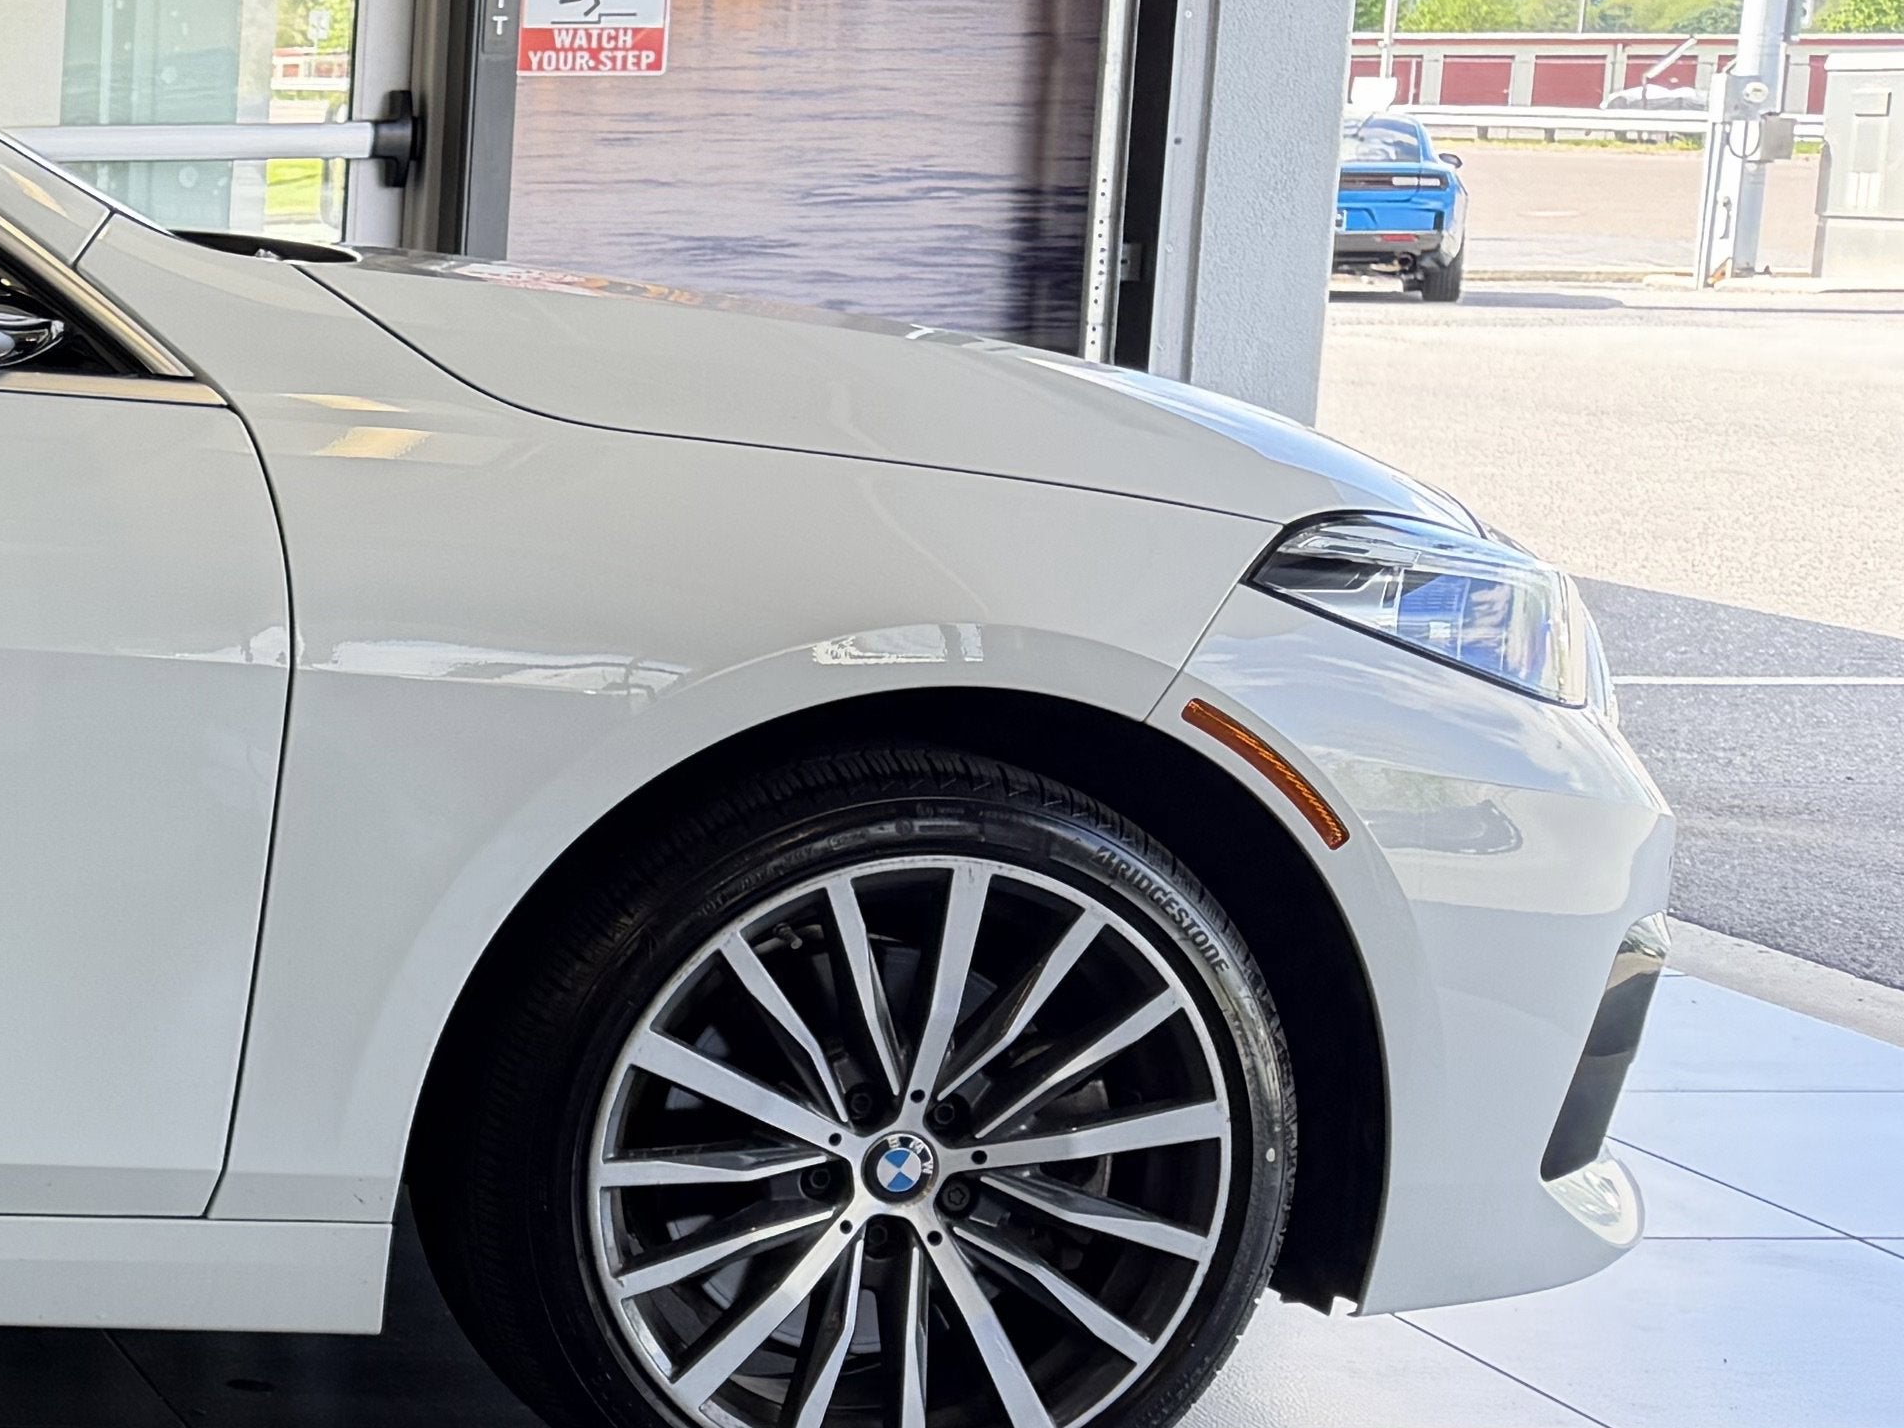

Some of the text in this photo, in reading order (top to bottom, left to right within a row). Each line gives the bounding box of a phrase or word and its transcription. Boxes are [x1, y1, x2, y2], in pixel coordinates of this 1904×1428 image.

[553, 28, 633, 49] WATCH
[528, 50, 656, 71] YOUR STEP
[1092, 845, 1230, 973] BRIDGESTONE
[886, 1134, 934, 1175] BMW
